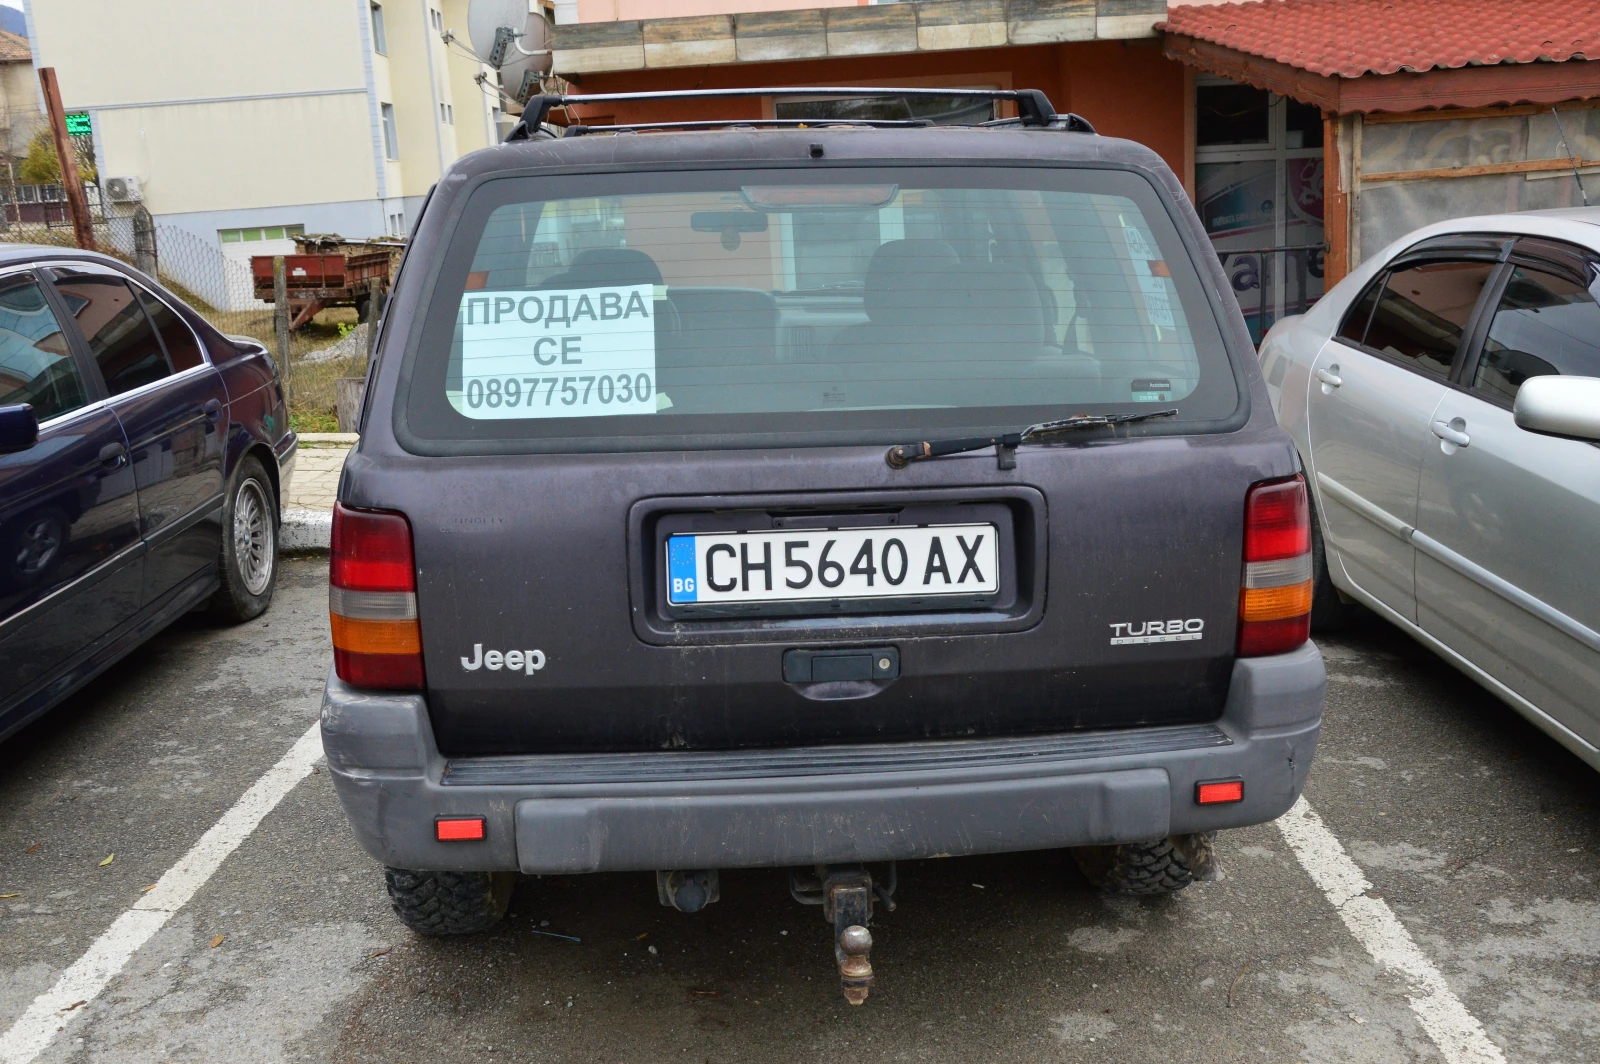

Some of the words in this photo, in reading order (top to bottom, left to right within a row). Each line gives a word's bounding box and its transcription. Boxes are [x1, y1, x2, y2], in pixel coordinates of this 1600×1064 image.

[467, 290, 649, 329] ПРОДАВА
[533, 336, 583, 366] СЕ
[467, 373, 651, 409] 0897757030
[673, 577, 695, 593] BG
[1109, 619, 1205, 637] TURBO
[1112, 634, 1201, 645] DIESEL
[460, 643, 546, 675] Jeep
